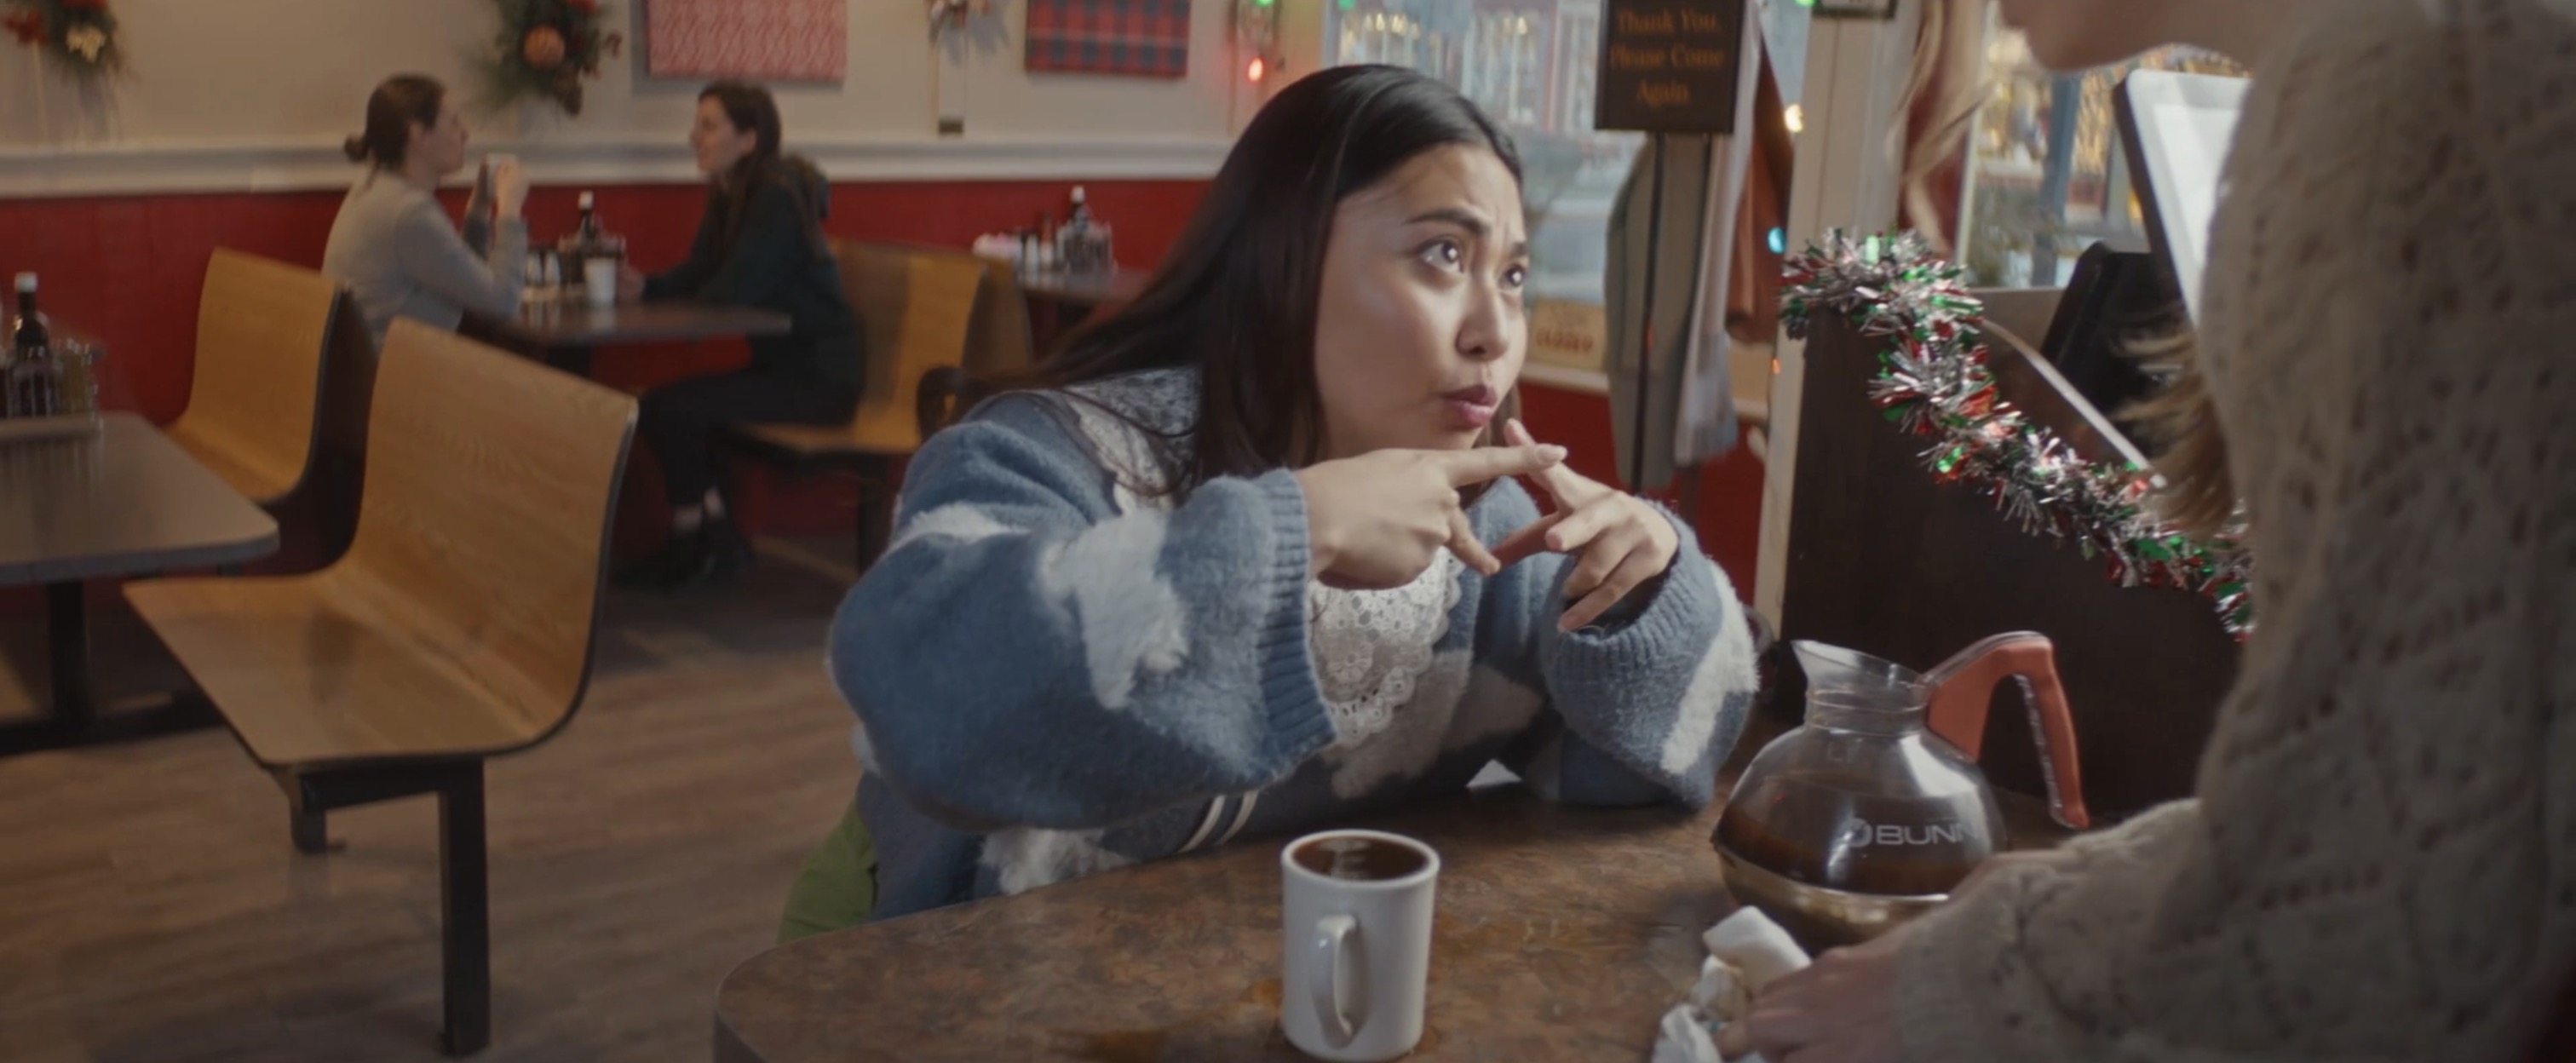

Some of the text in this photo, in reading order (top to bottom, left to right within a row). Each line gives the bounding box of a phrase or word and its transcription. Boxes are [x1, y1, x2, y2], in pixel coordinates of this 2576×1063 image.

[1618, 9, 1676, 37] Thank
[1610, 43, 1725, 71] Please Come
